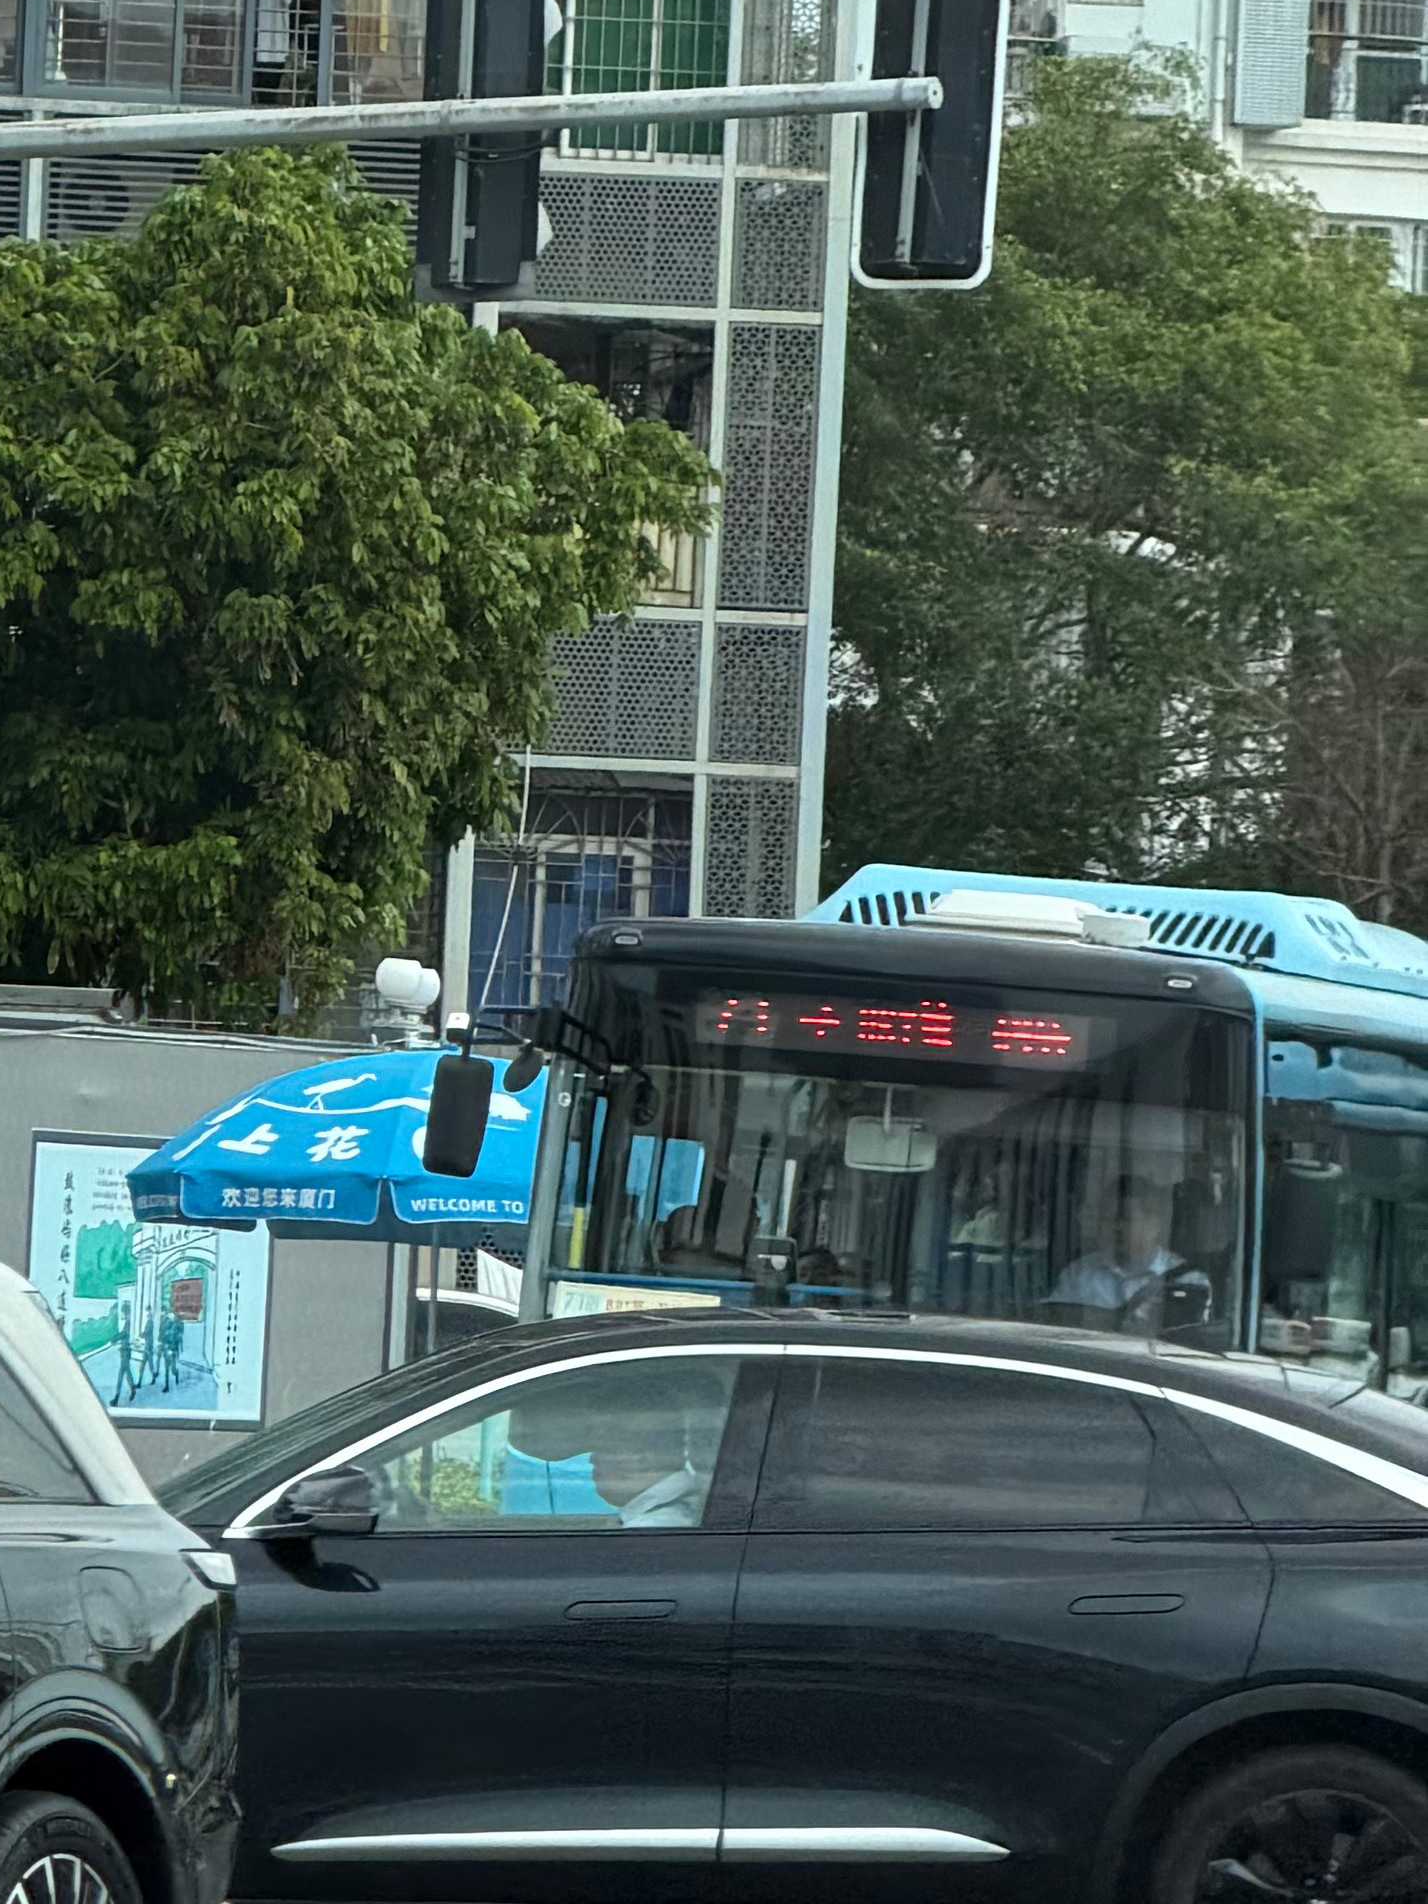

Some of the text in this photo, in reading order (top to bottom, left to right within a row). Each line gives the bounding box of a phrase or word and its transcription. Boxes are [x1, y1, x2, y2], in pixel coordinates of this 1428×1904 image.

[222, 1187, 336, 1210] 欢迎您来厦门
[411, 1198, 525, 1214] WELCOME TO
